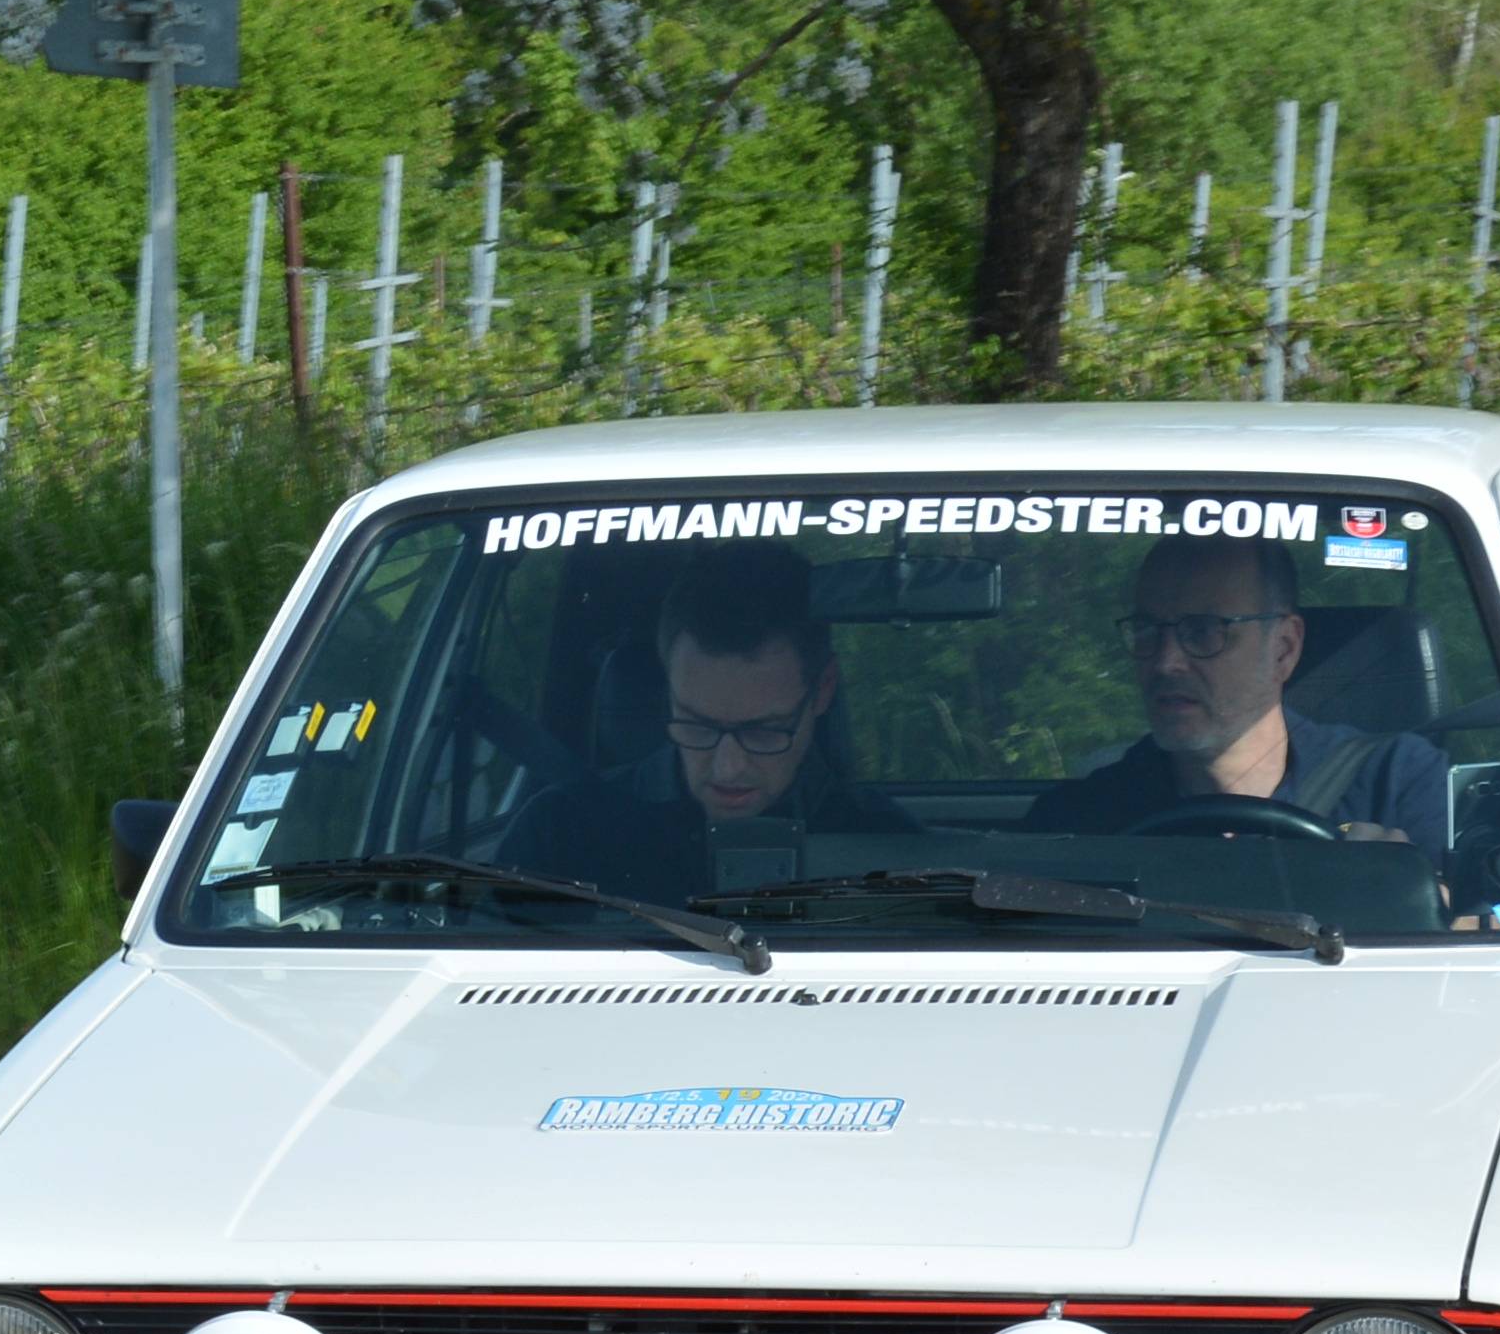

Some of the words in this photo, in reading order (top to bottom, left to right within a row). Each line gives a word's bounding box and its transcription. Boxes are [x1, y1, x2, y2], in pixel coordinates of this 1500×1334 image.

[482, 496, 1319, 554] HOFFMANN-SPEEDSTER.COM
[551, 1098, 723, 1125] RAMBERG
[724, 1099, 898, 1126] HISTORIC
